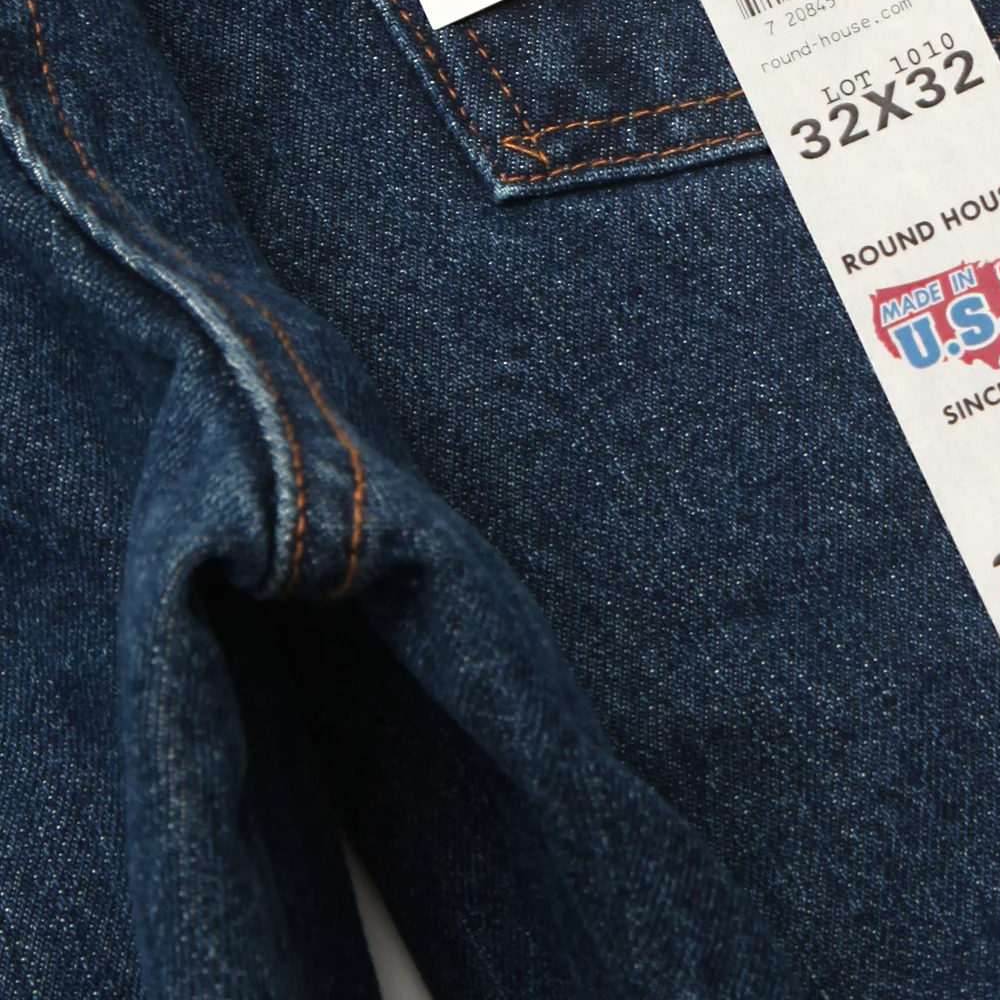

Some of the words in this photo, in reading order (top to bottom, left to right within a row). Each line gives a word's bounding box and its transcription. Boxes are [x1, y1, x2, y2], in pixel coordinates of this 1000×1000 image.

[764, 21, 774, 36] 7
[821, 70, 874, 104] LOT
[890, 32, 955, 74] 1010
[790, 50, 985, 159] 32X32
[841, 220, 935, 275] ROUND
[880, 285, 942, 324] MADE
[951, 267, 976, 293] IN
